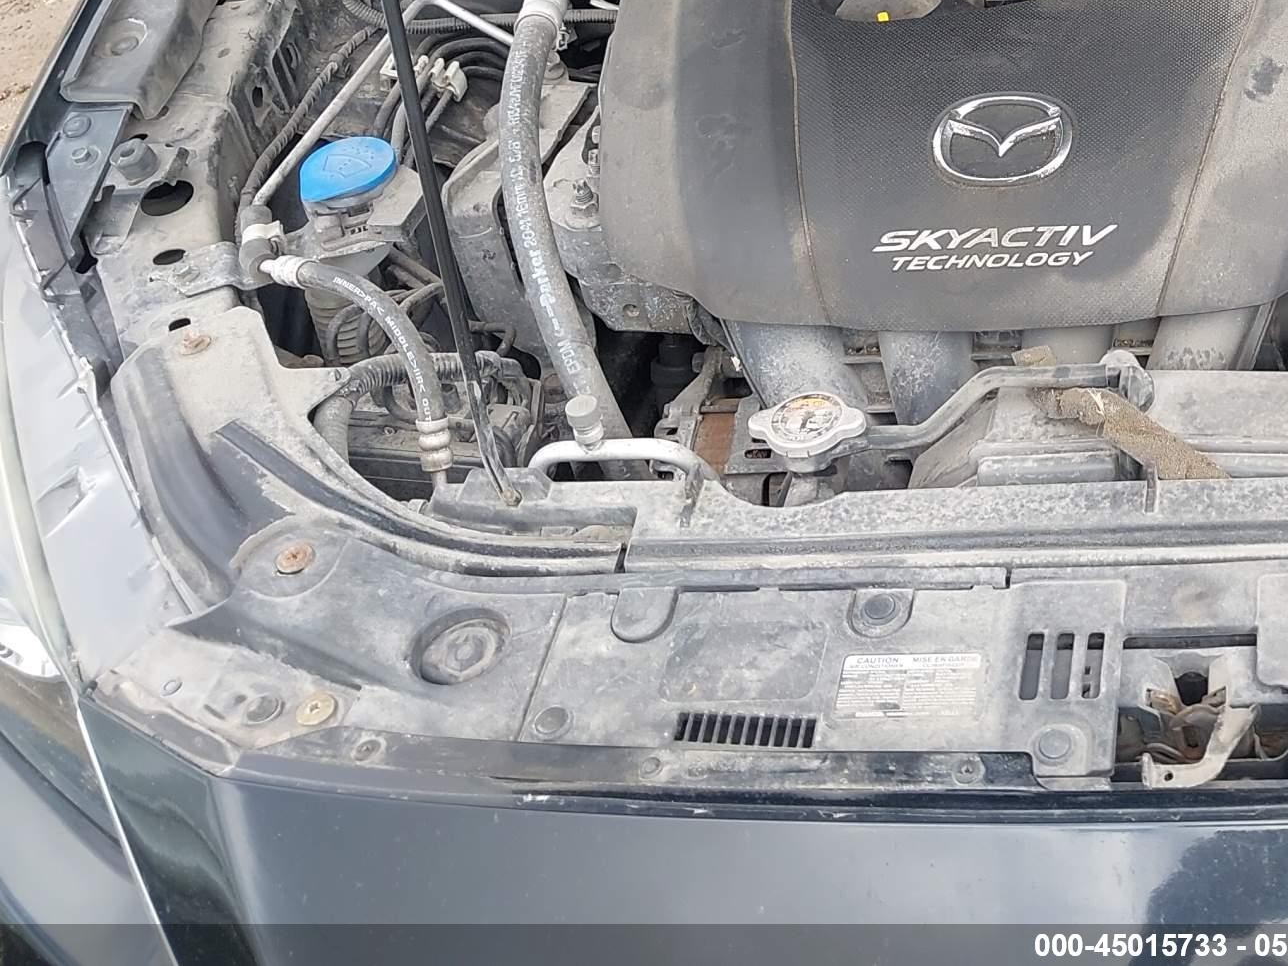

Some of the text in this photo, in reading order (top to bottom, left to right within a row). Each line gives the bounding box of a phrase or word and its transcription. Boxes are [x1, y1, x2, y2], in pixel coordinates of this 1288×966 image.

[872, 224, 1119, 253] SKYACTIV
[891, 250, 1093, 272] TECHNOLOGY
[528, 249, 556, 307] Parker
[557, 338, 580, 375] EPDM
